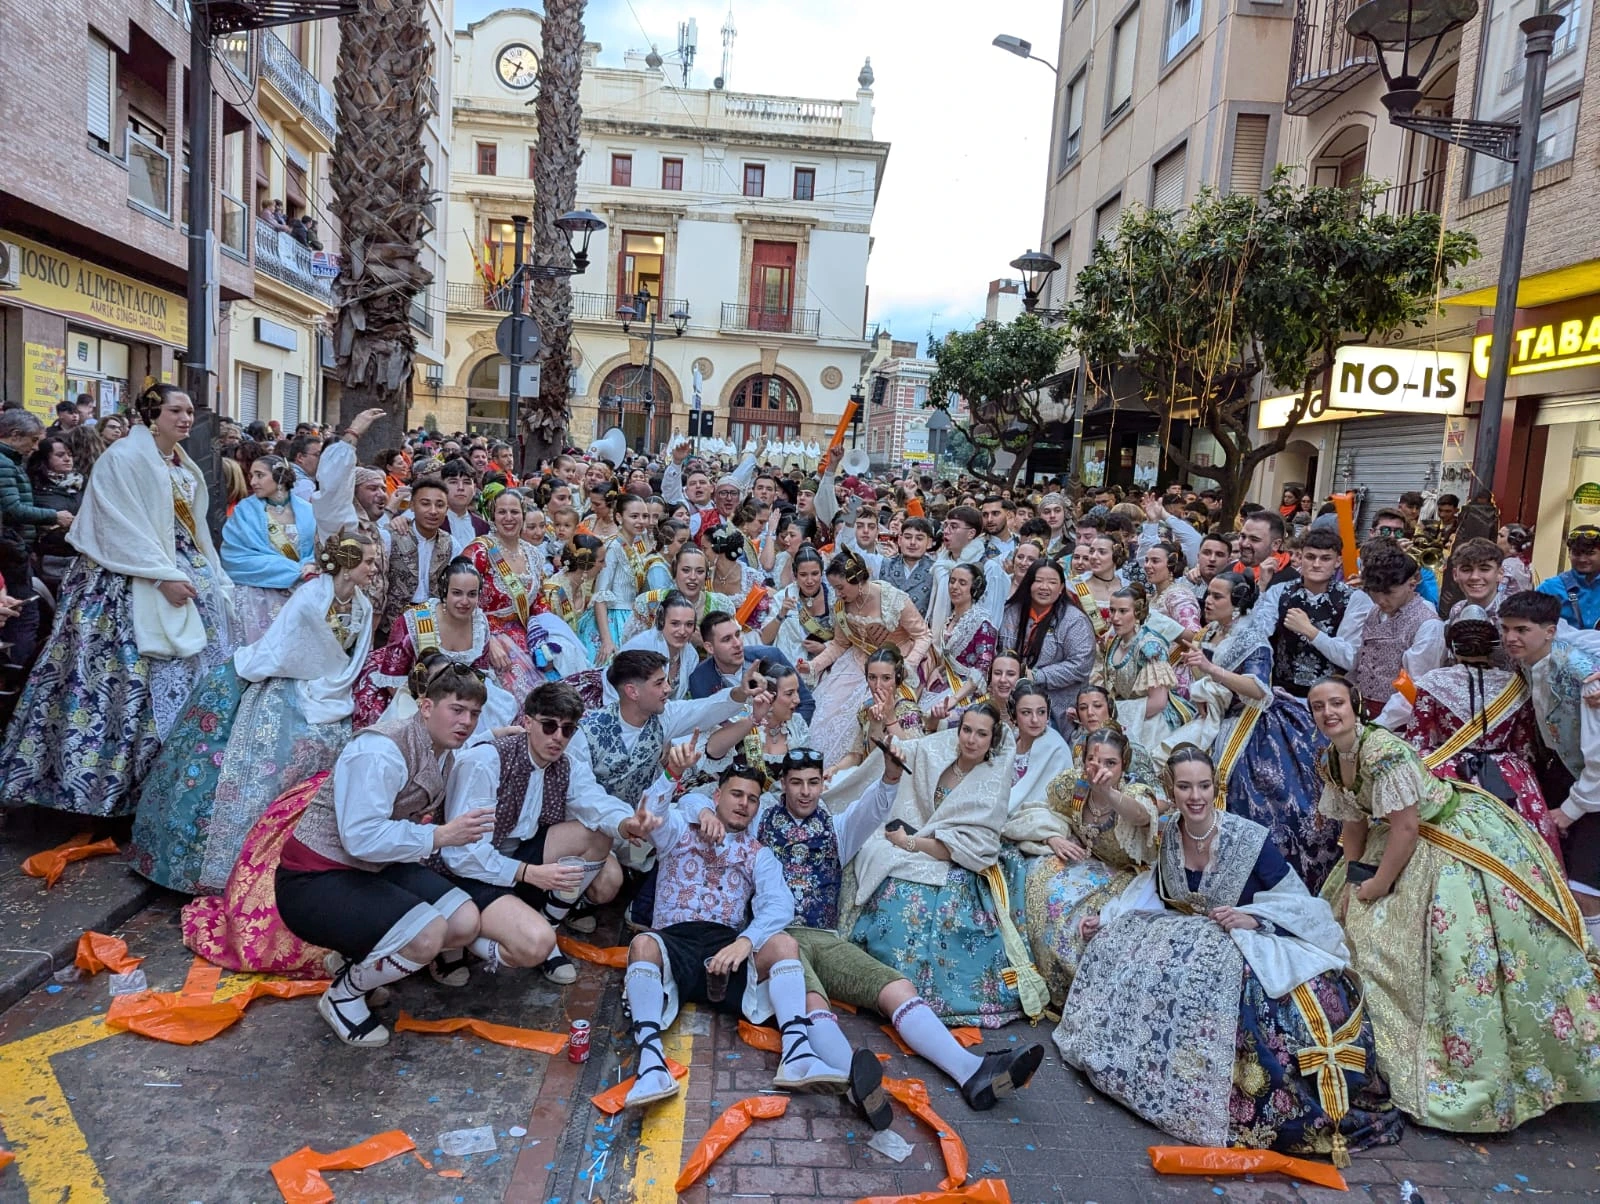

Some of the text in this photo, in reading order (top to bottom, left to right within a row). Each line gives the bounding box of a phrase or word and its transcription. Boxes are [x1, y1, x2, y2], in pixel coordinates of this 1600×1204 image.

[21, 246, 168, 320] IOSKO ALIMENTACION
[90, 300, 167, 334] AMRIK SINGH DHILLON
[1340, 362, 1457, 399] NO-IS
